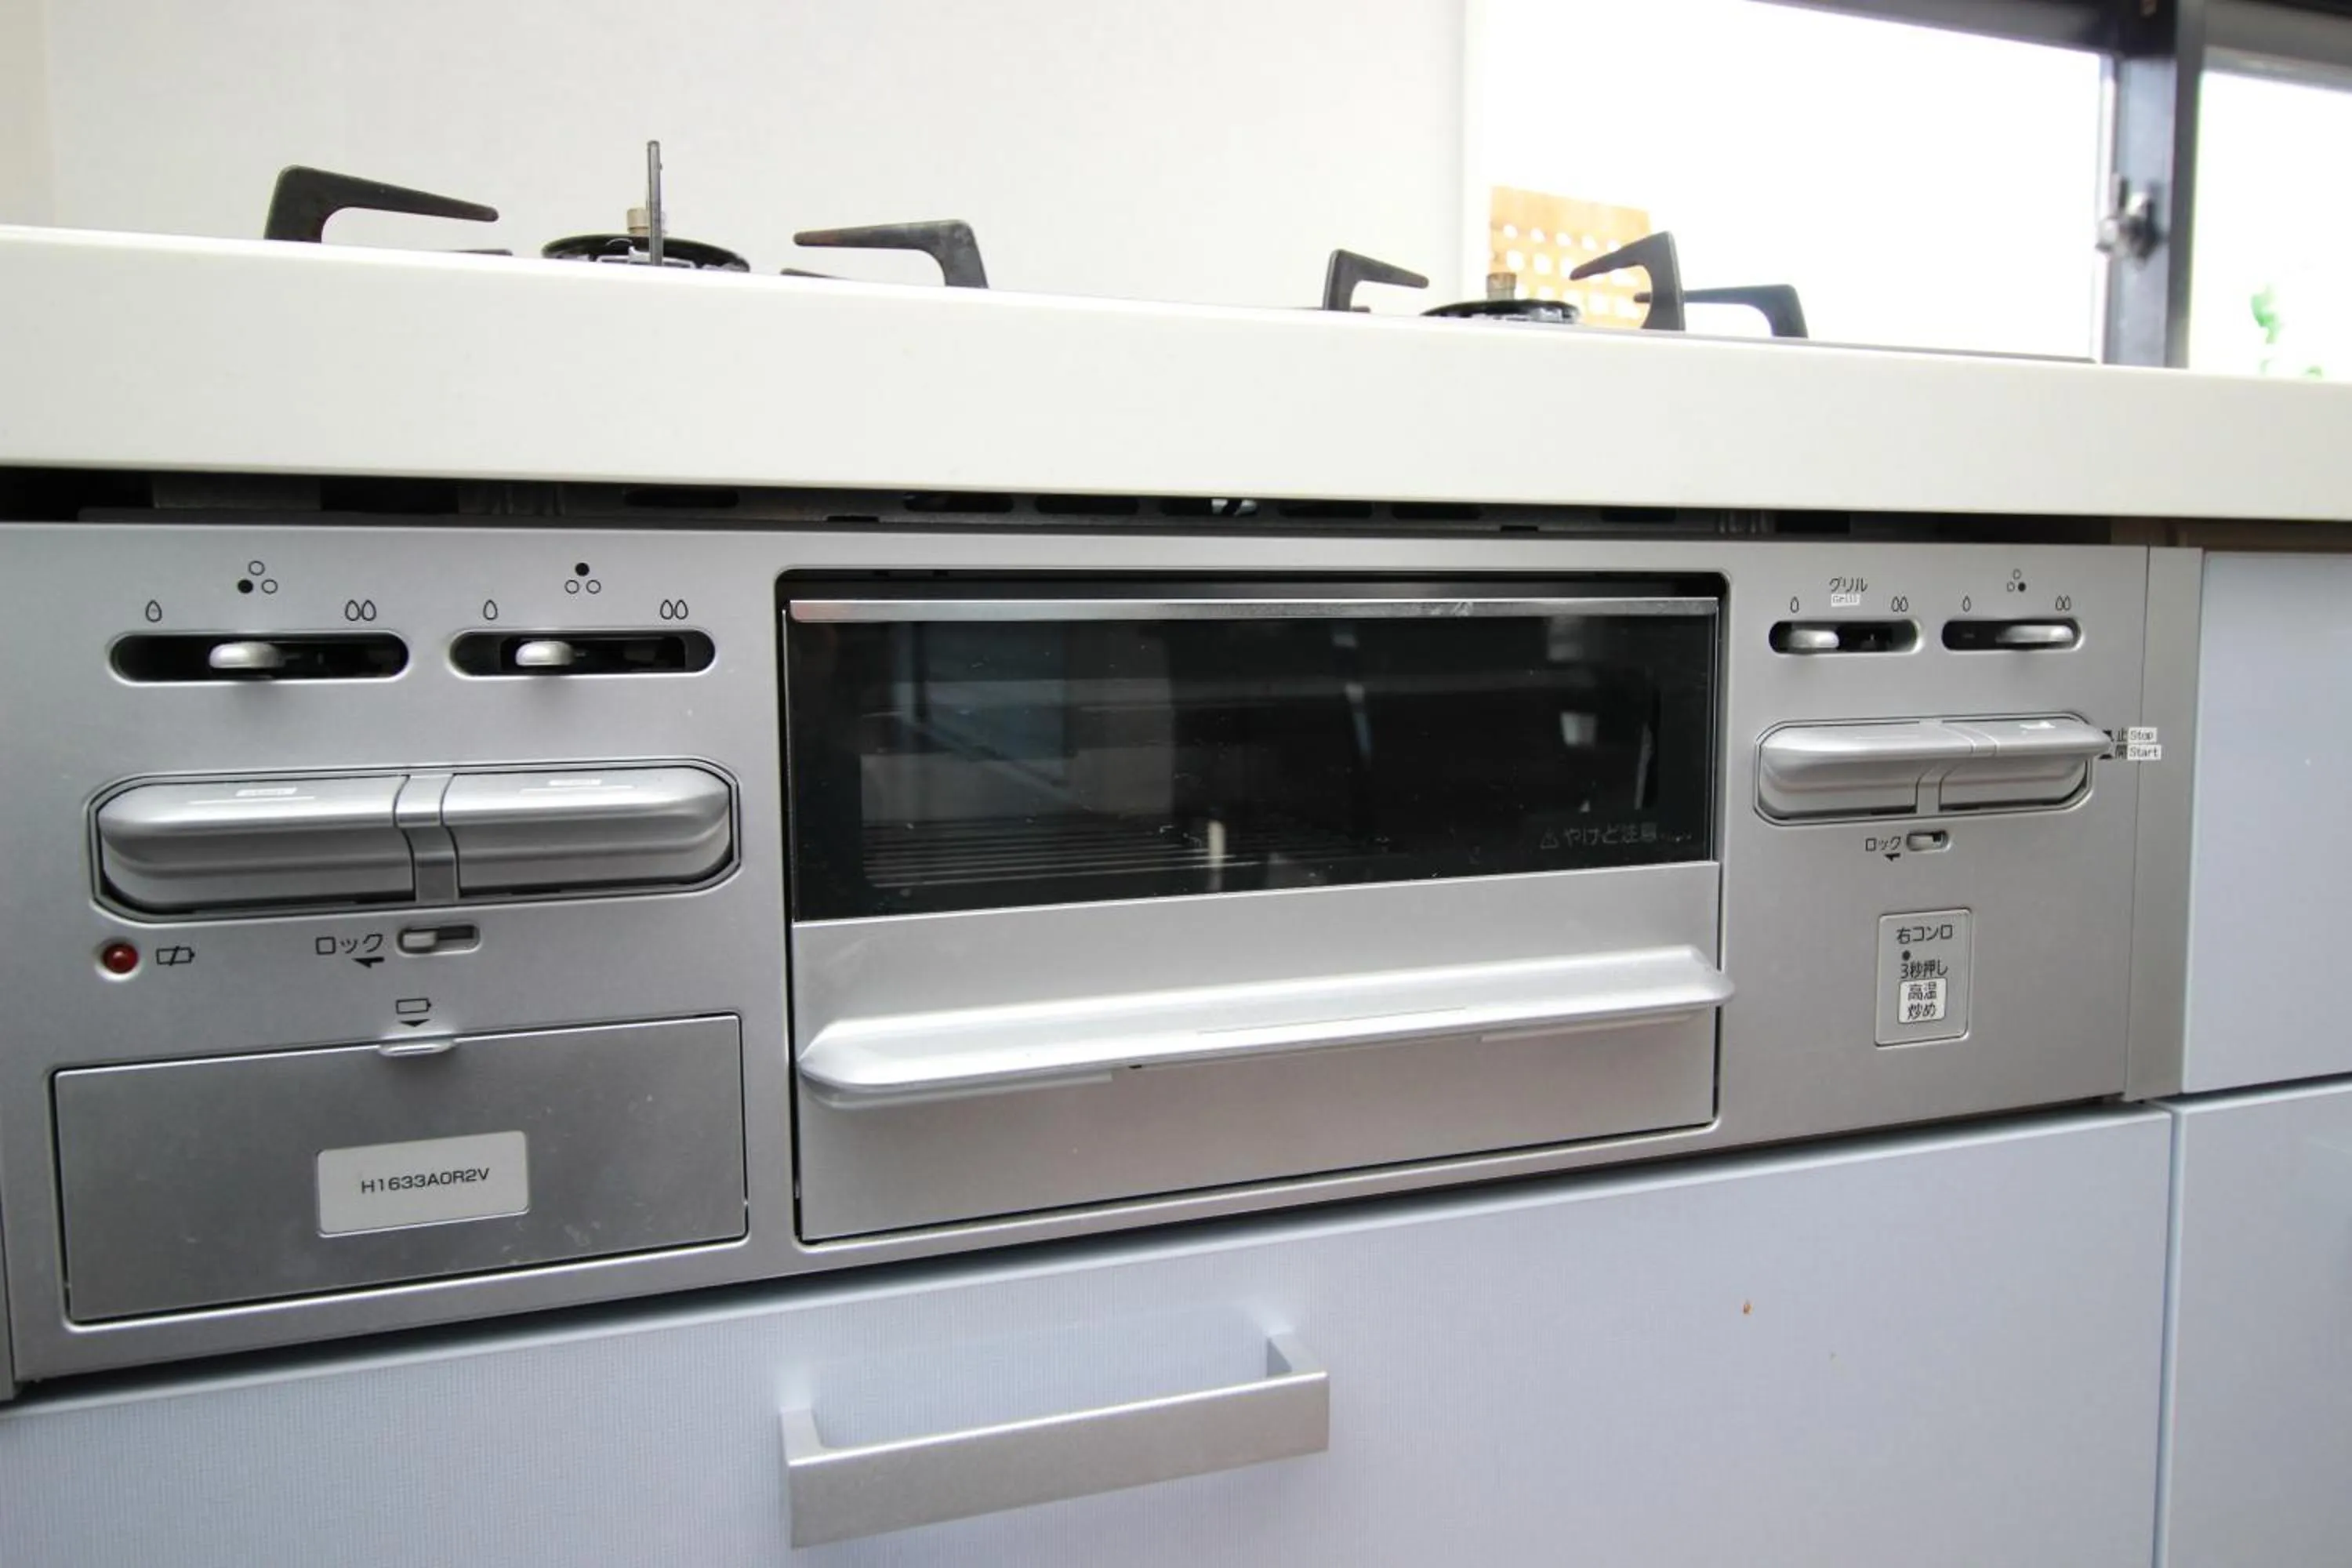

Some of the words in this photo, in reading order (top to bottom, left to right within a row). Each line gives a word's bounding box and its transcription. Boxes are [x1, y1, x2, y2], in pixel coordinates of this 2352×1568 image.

[1829, 577, 1867, 593] グリル
[2129, 746, 2158, 759] Start
[1865, 836, 1901, 851] ロック
[1896, 924, 1953, 944] 右コンロ
[316, 933, 384, 956] ロック
[1900, 960, 1948, 978] 3秒押し
[1907, 982, 1936, 1000] 高温
[1907, 1003, 1936, 1020] 炒め
